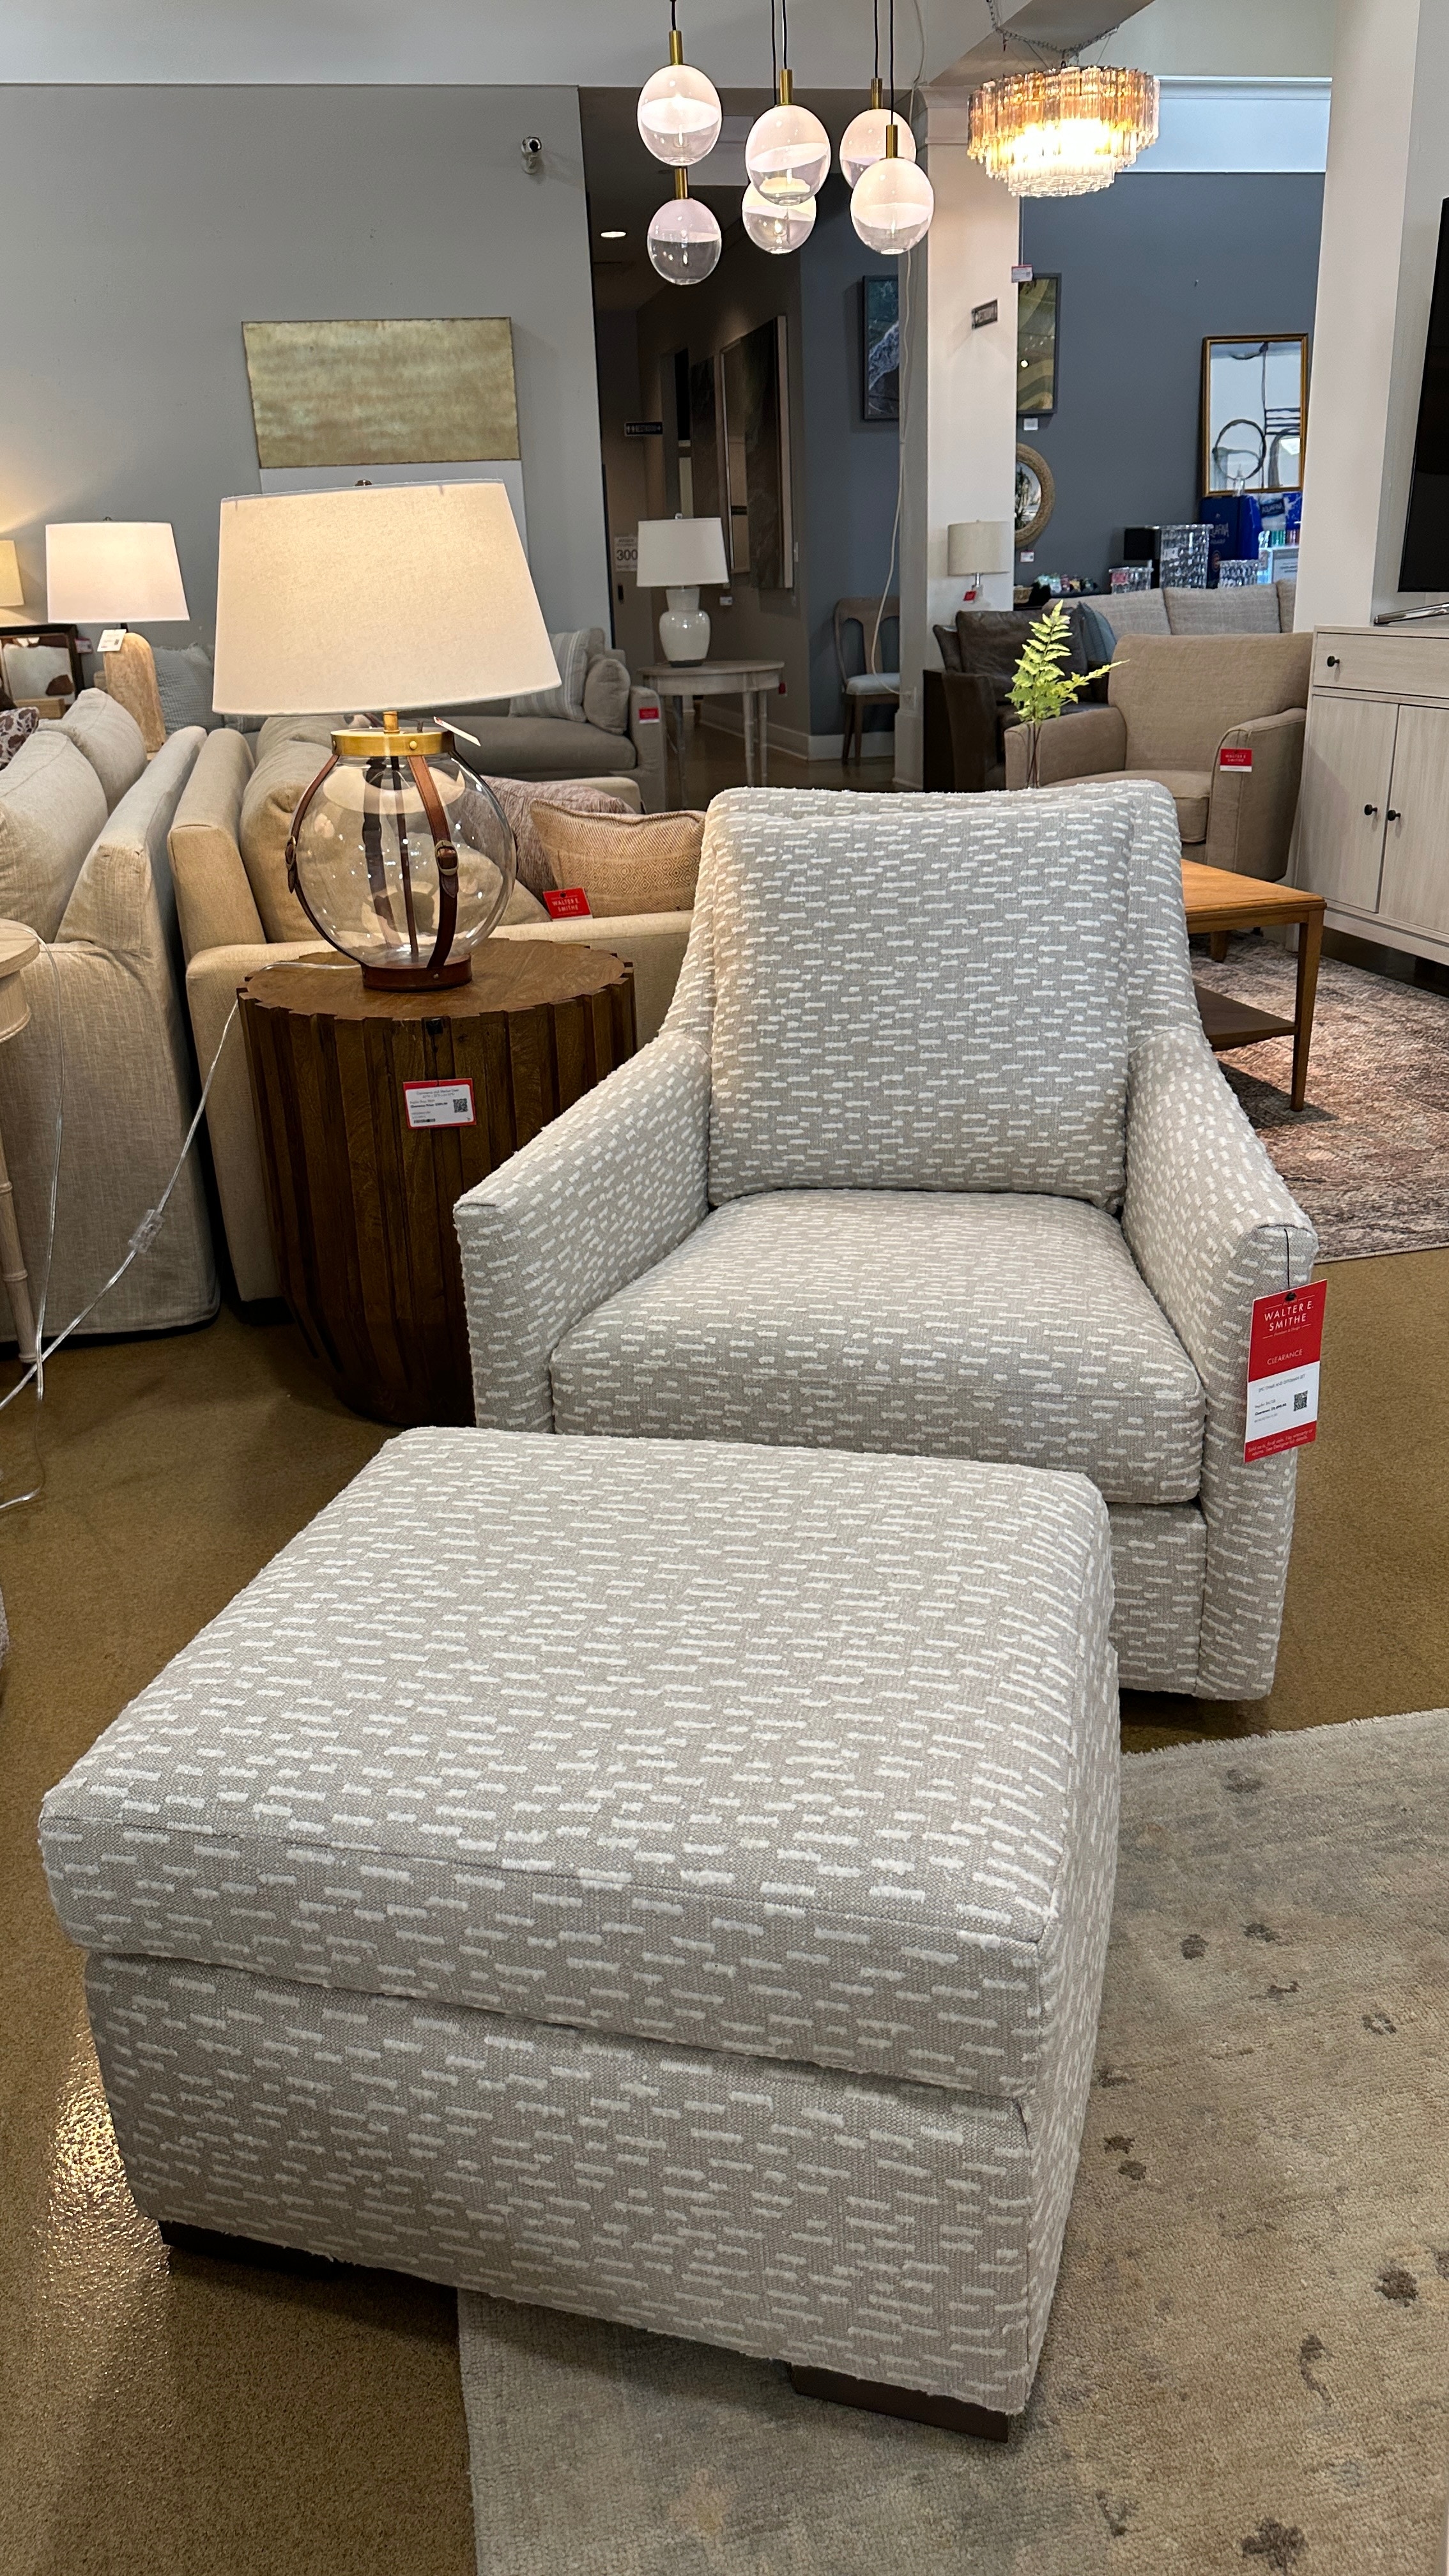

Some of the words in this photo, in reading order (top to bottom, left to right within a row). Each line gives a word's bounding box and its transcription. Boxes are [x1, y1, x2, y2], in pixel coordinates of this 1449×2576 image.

[1264, 1303, 1303, 1321] WALTER
[1269, 1313, 1307, 1331] SMITHE
[1267, 1349, 1303, 1365] CLEARANCE
